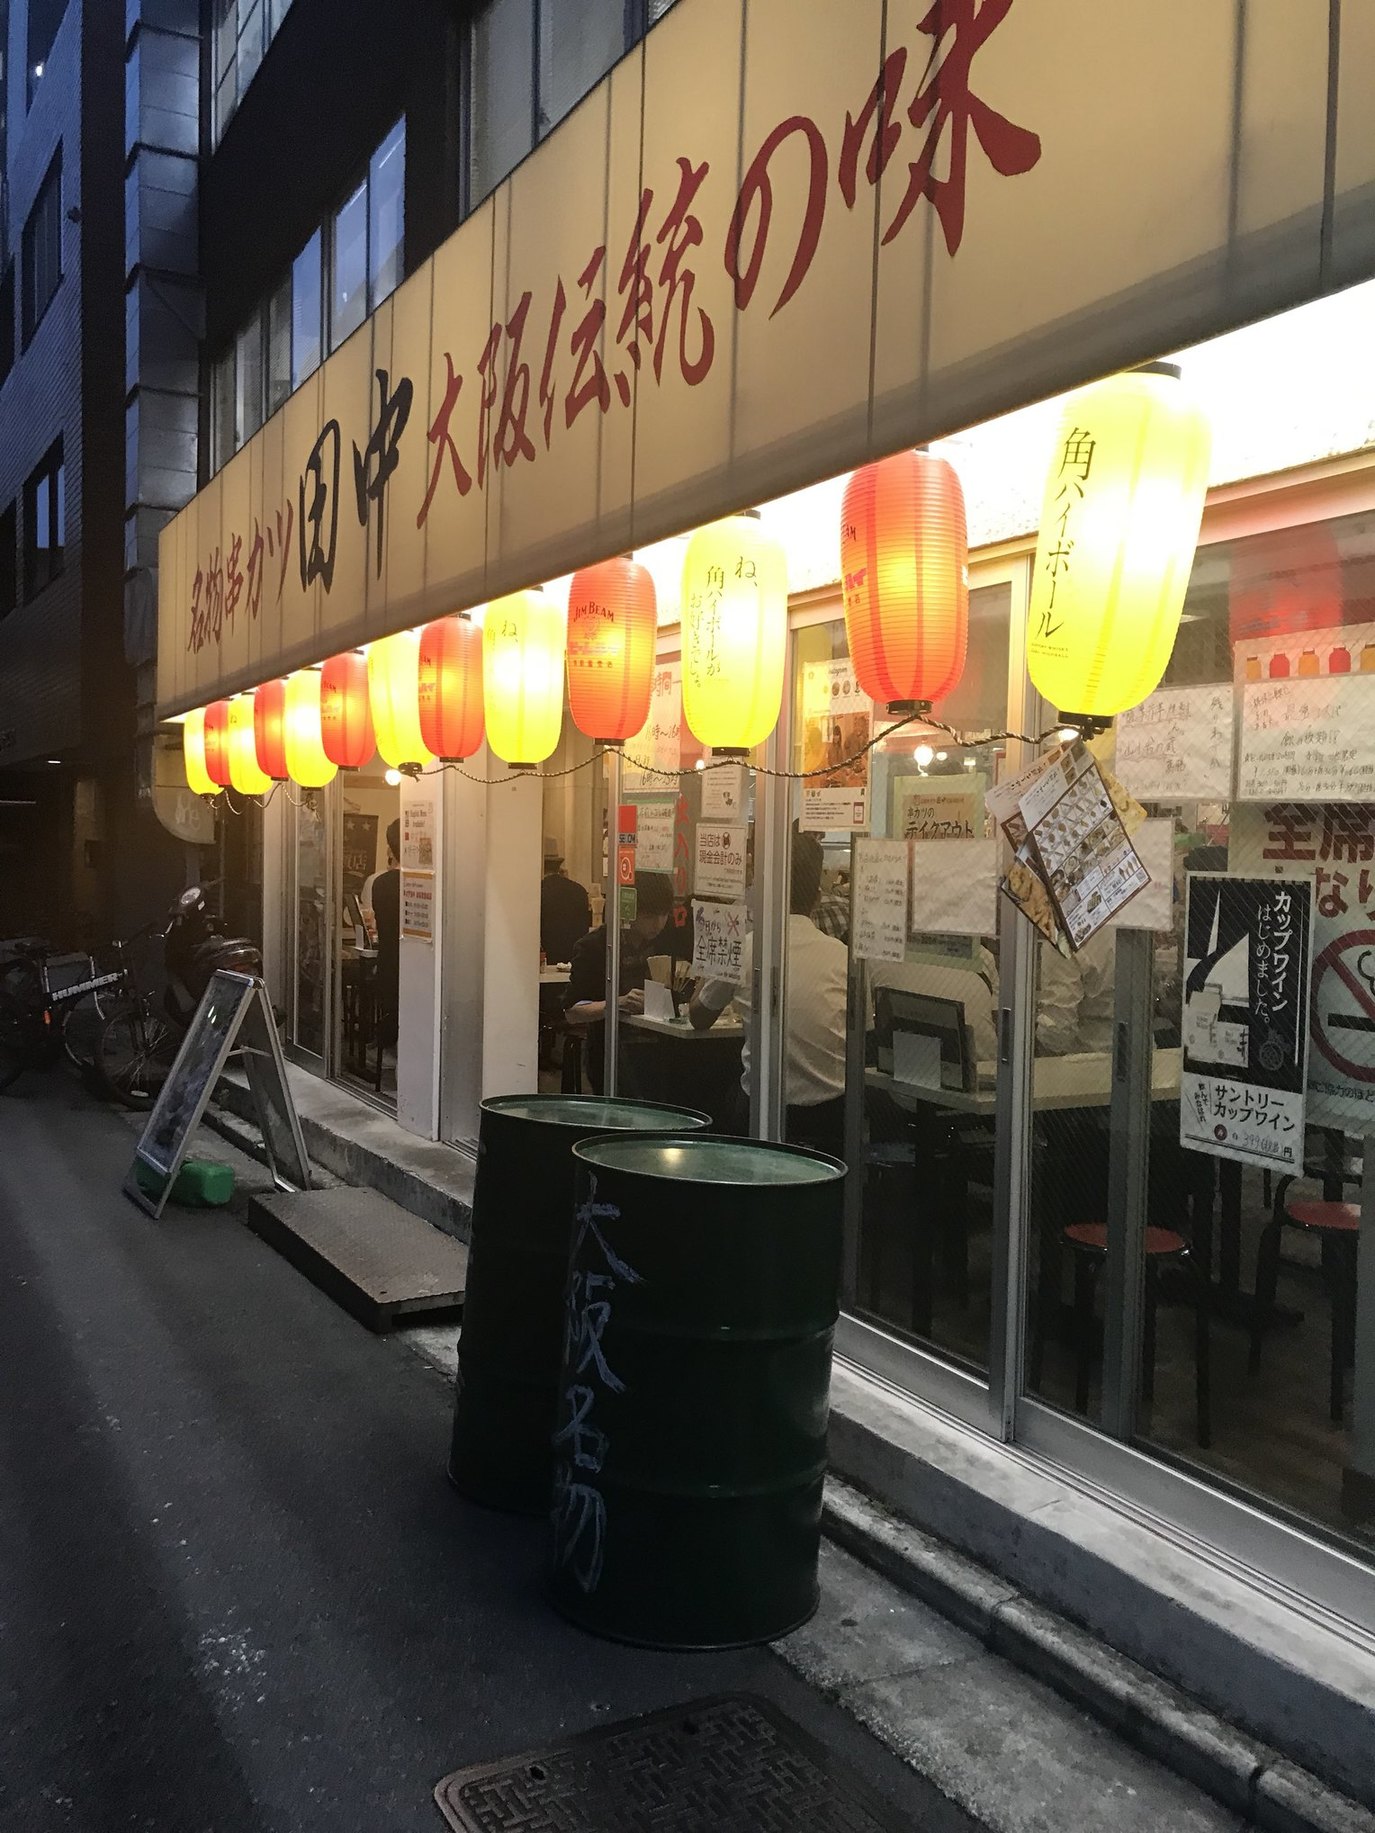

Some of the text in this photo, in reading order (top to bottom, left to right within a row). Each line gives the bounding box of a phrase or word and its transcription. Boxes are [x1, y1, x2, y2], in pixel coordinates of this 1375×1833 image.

[299, 369, 414, 594] 田中
[416, 0, 1042, 530] 大阪伝統の味
[1034, 427, 1097, 639] 角ハイボール
[573, 601, 615, 622] JIM BEAM
[618, 833, 637, 843] SEOM
[904, 820, 975, 839] テイクアウト
[1254, 904, 1272, 1025] はじめました。
[1272, 891, 1293, 1012] カップワイン
[52, 972, 119, 1001] HUMMER
[1215, 1085, 1285, 1110] サントリー
[1213, 1102, 1295, 1132] カップワイン
